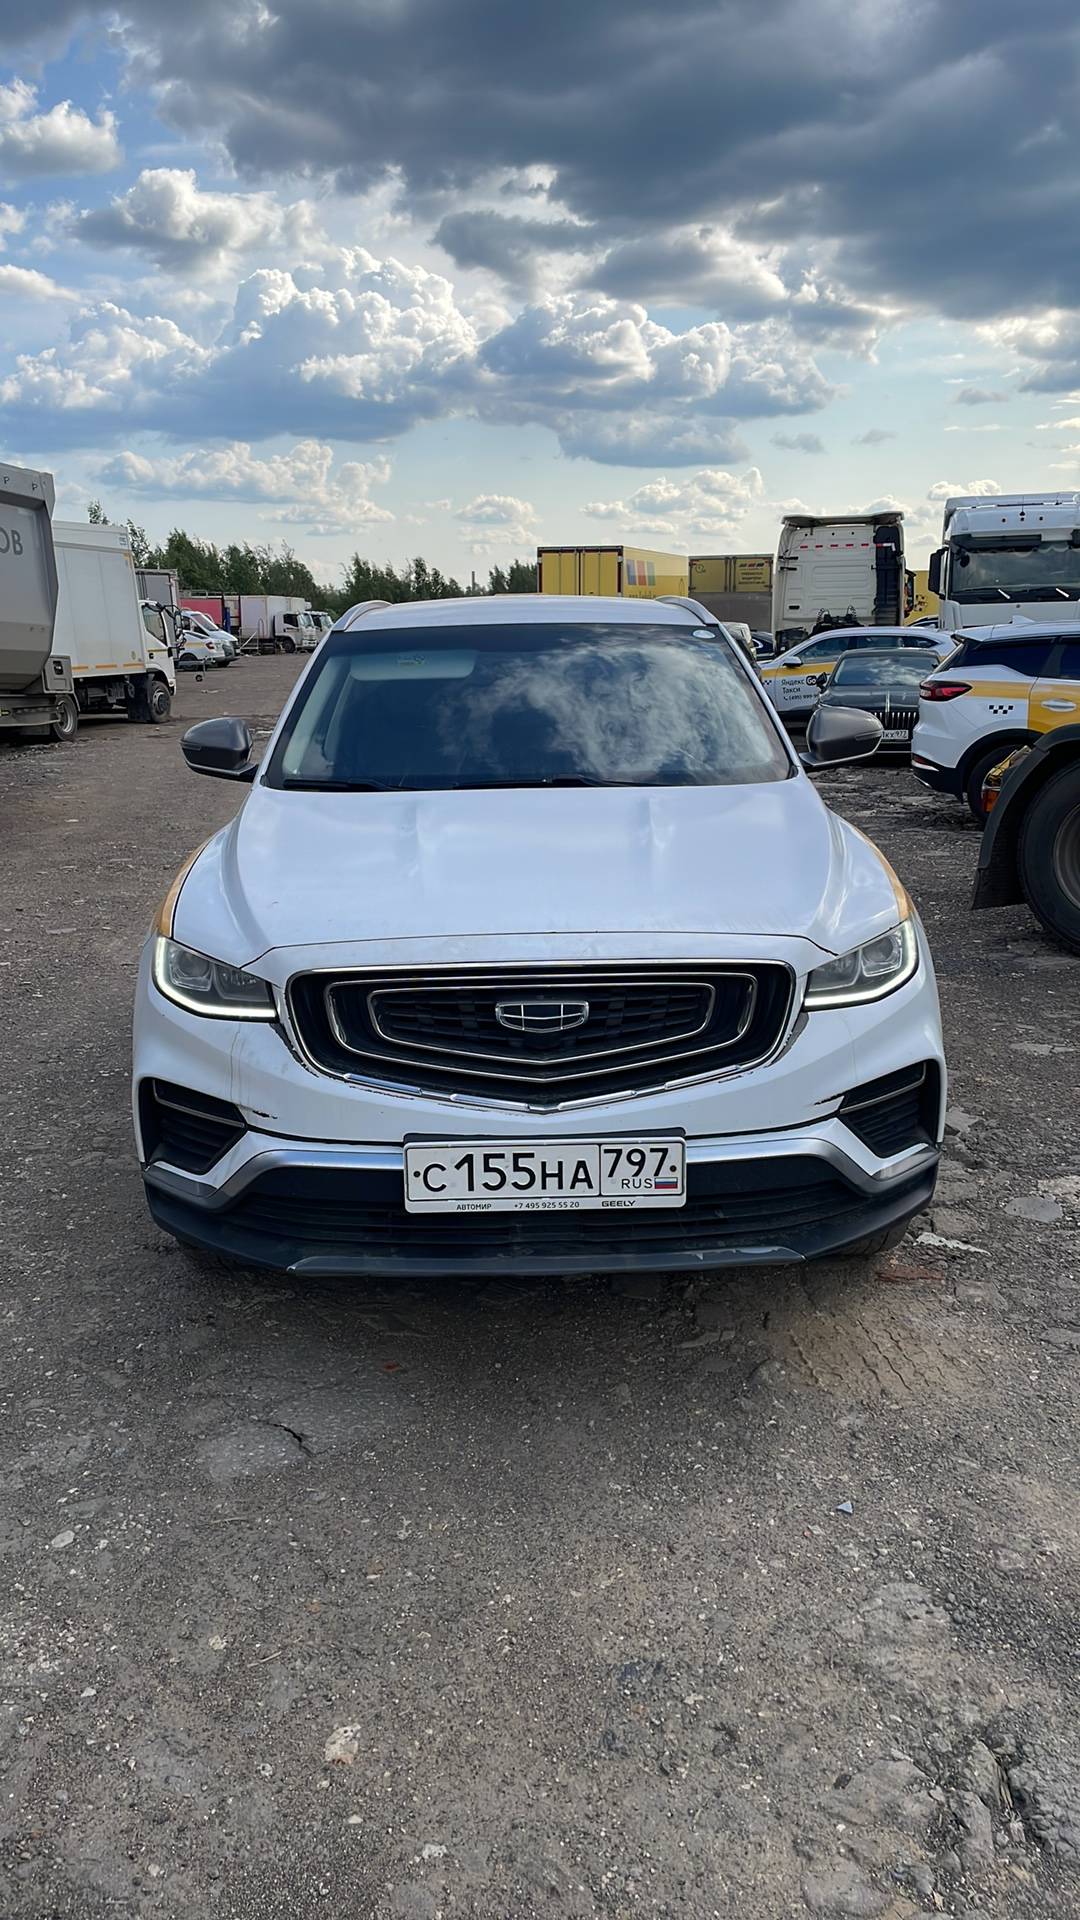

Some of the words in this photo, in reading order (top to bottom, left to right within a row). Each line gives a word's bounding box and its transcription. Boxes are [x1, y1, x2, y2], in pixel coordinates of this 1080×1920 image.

[806, 676, 817, 685] Go
[423, 1152, 594, 1192] С155НА
[603, 1148, 669, 1178] 797
[621, 1178, 653, 1189] RUS
[456, 1203, 492, 1211] АВТОМИР
[541, 1201, 556, 1209] 925
[601, 1200, 636, 1208] GEELY
